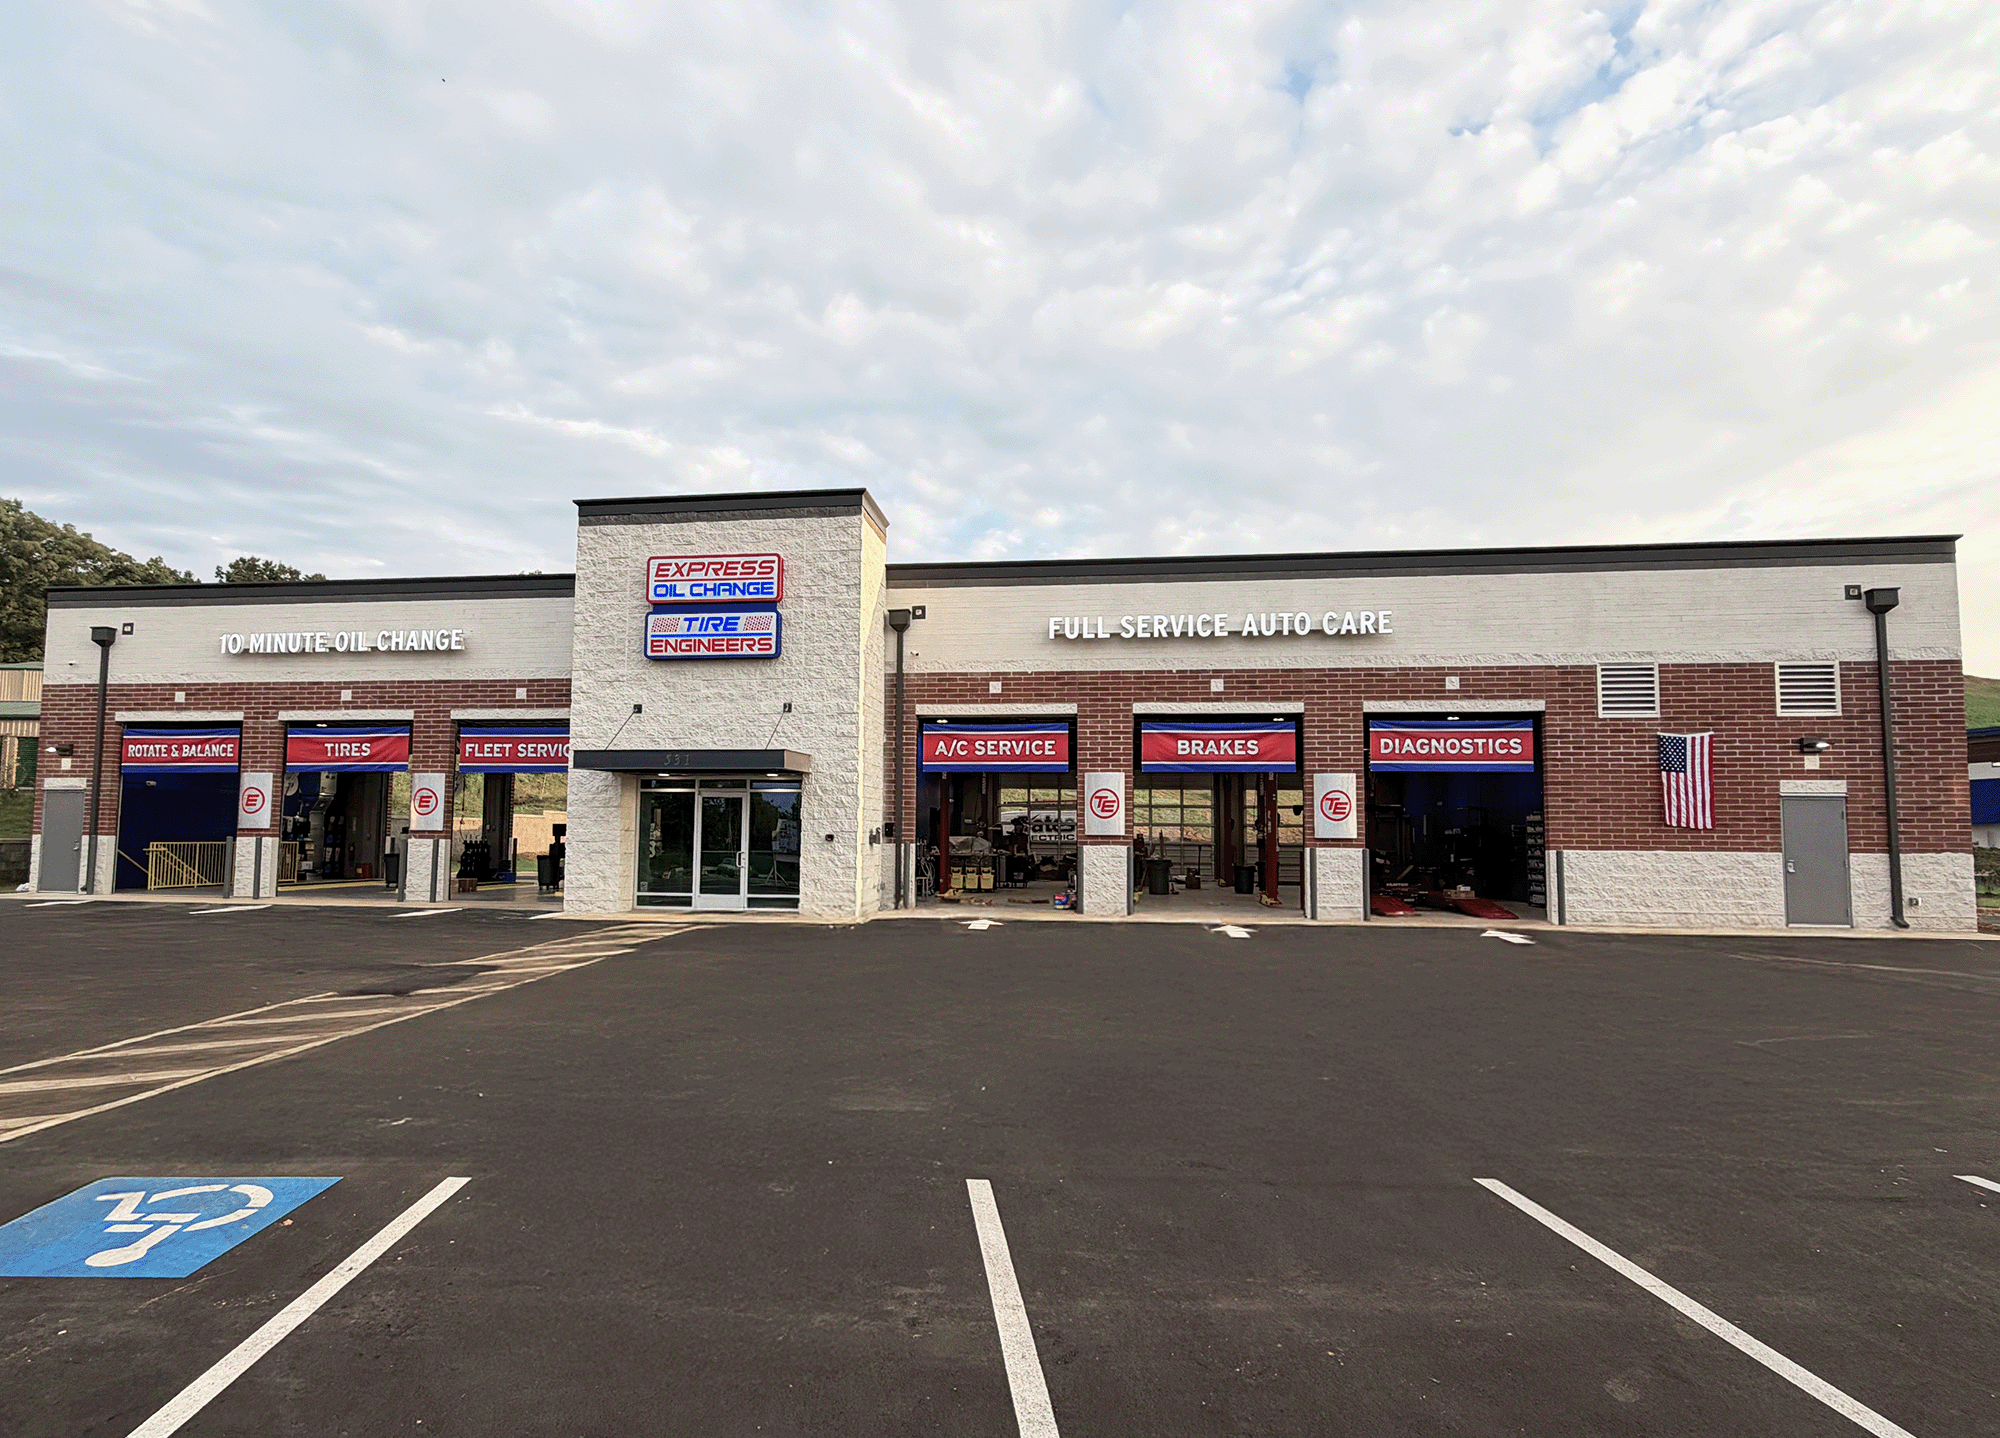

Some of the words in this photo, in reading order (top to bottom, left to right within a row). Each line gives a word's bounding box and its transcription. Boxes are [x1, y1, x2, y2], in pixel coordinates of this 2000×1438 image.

[654, 560, 776, 578] EXPRESS
[653, 583, 685, 598] OIL
[690, 581, 774, 597] CHANGE
[683, 616, 741, 632] TIRE
[1049, 616, 1111, 640] FULL
[1120, 613, 1228, 639] SERVICE
[1242, 612, 1311, 637] AUTO
[1322, 610, 1393, 636] CARE
[219, 633, 243, 654] 10
[249, 631, 328, 654] MINUTE
[335, 630, 370, 653] OIL
[376, 629, 464, 651] CHANGE
[650, 637, 773, 654] ENGINEERS
[127, 744, 168, 758] ROTATE
[171, 744, 179, 757] &
[182, 743, 235, 757] BALANCE
[324, 743, 371, 757] TIRES
[465, 743, 513, 757] FLEET
[517, 743, 570, 758] SERVIC
[934, 739, 968, 757] A/C
[974, 740, 1056, 756] SERVICE
[1177, 739, 1259, 755] BRAKES
[1380, 738, 1523, 755] DIAGNOSTICS
[663, 753, 690, 766] 531
